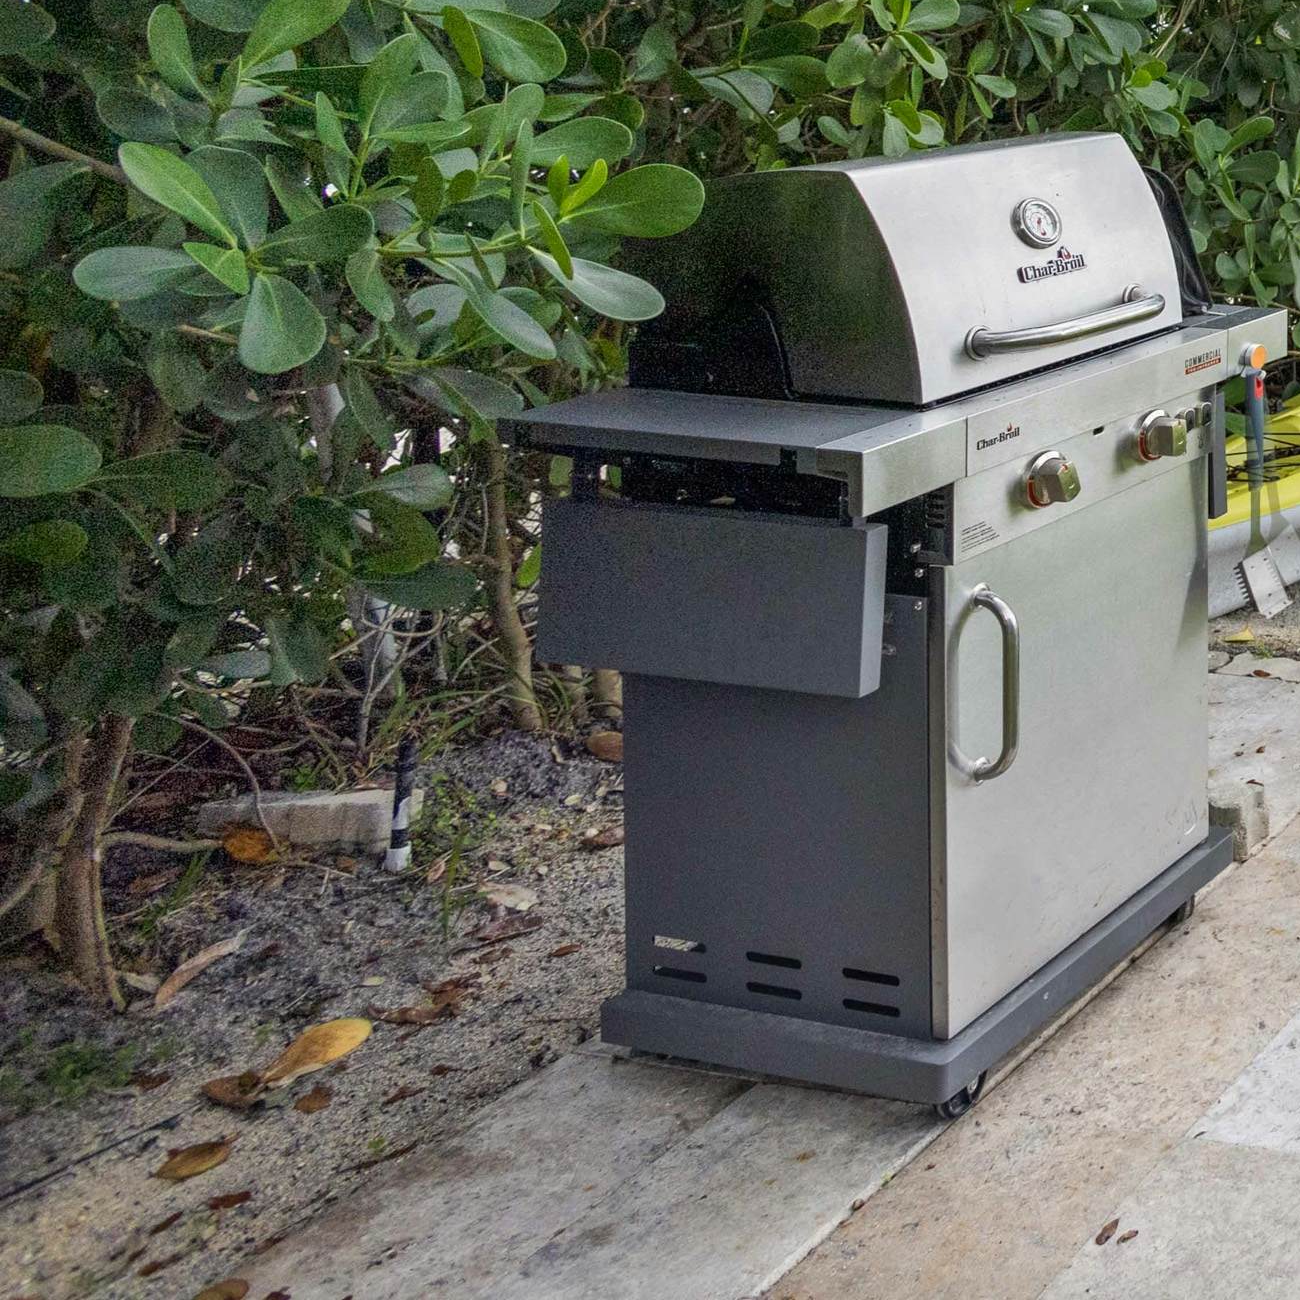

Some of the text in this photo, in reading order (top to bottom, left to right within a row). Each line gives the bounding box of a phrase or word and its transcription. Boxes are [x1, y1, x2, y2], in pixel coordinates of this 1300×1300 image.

[1023, 254, 1085, 281] Char-Broil
[1184, 348, 1221, 368] COMMERCIAL
[976, 426, 1020, 450] Char-Broil
